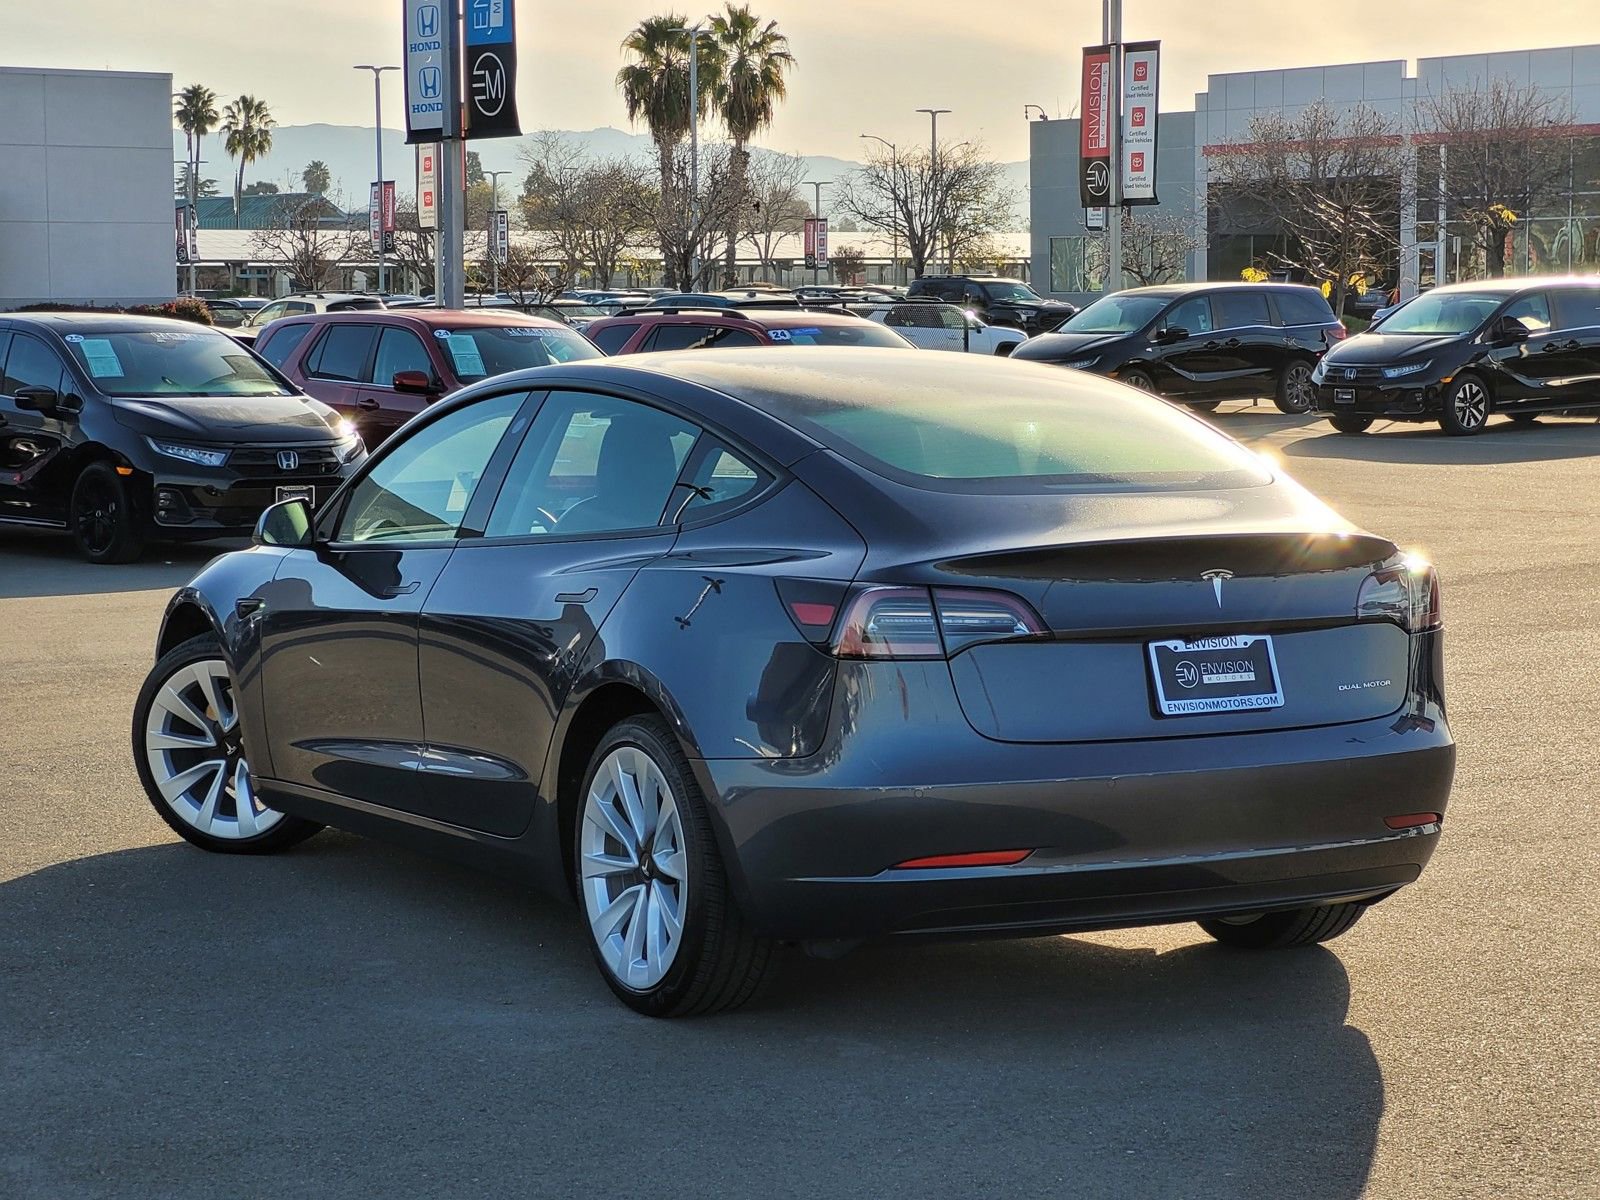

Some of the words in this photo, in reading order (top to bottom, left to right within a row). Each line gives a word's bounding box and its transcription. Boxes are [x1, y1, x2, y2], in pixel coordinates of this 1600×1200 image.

[409, 41, 441, 53] HOND
[412, 102, 443, 114] HOND
[1088, 62, 1101, 149] ENVISION
[772, 331, 787, 339] 24
[1185, 637, 1238, 650] ENVISION
[1201, 660, 1255, 675] ENVISION
[1338, 683, 1361, 691] DUAL
[1363, 680, 1391, 688] MOTOR
[1167, 696, 1279, 713] ENVISIONMOTORS.COM
